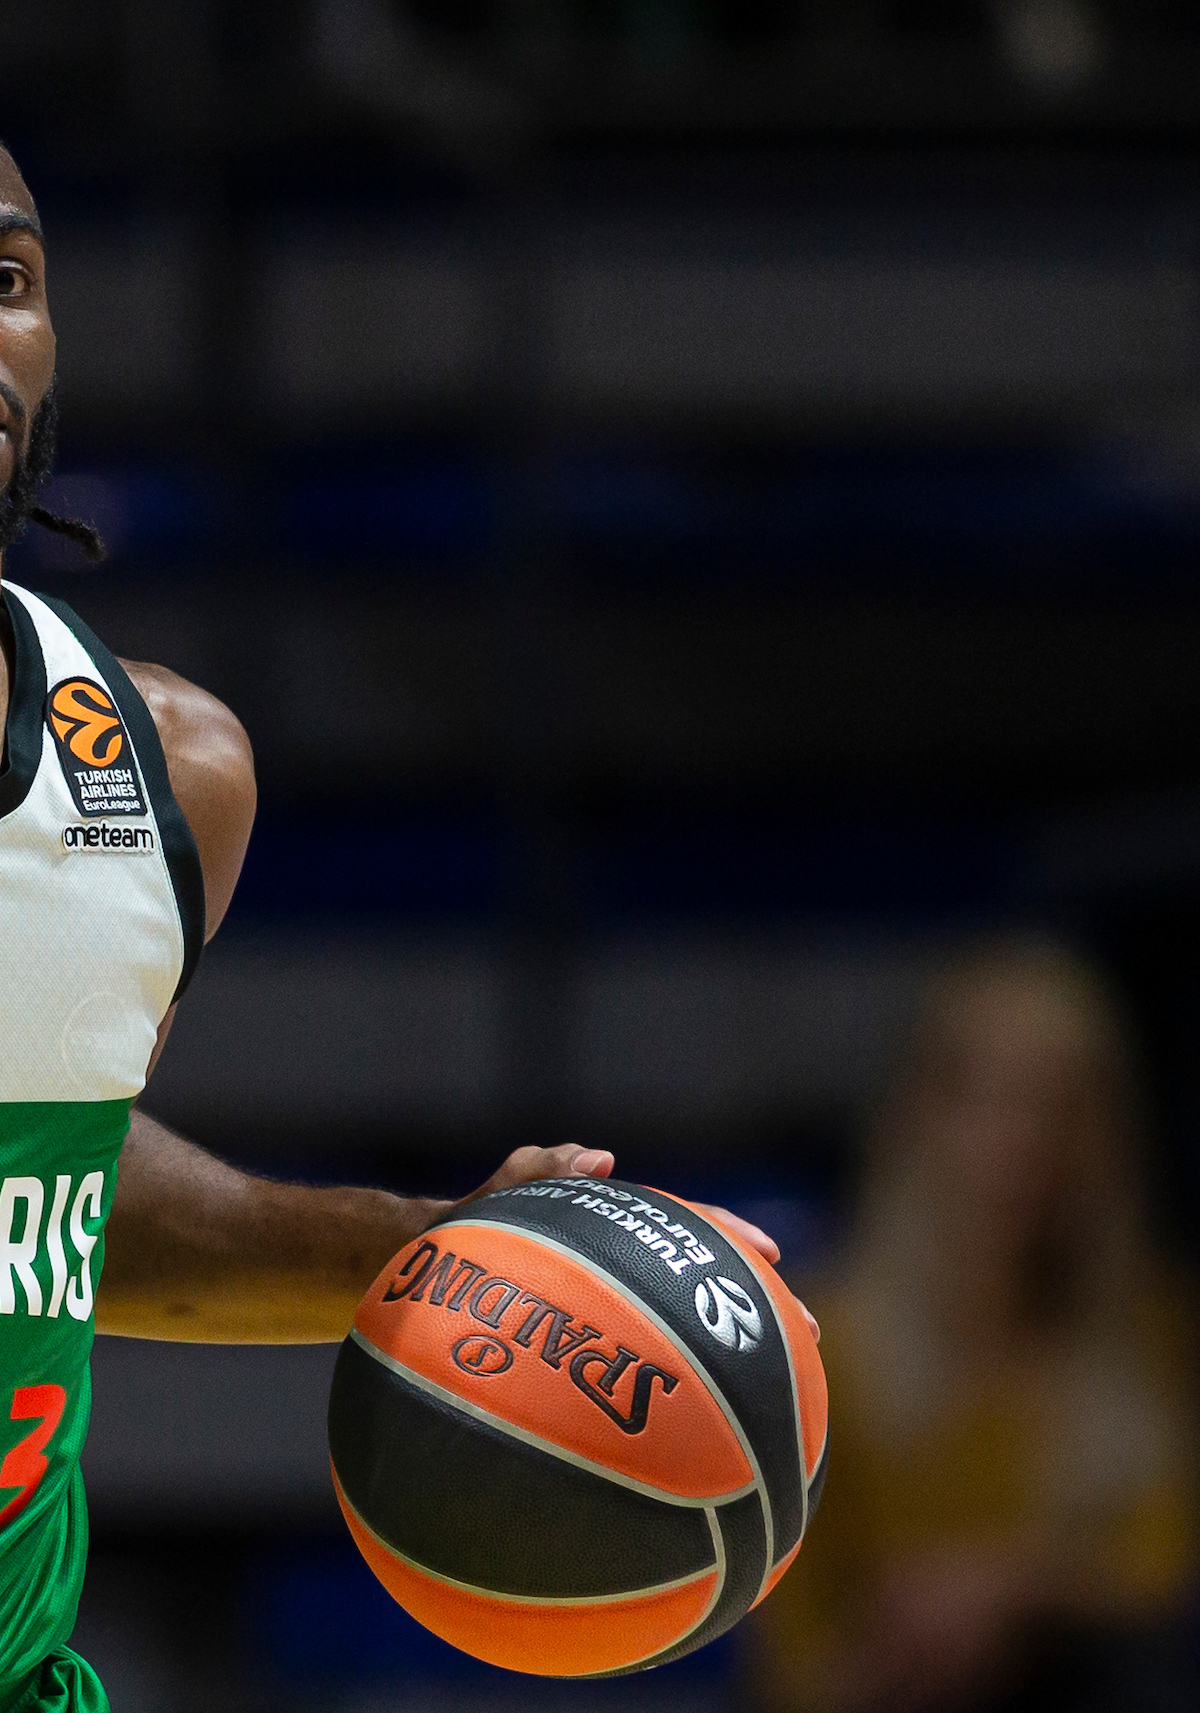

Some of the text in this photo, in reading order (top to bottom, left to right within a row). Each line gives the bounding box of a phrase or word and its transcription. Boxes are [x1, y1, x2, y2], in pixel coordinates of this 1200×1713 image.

[73, 769, 134, 785] TURKISH
[80, 783, 137, 799] AIRLINES
[83, 799, 141, 812] EuroLeague
[570, 1193, 692, 1276] TURKISH
[380, 1239, 680, 1436] SPALDING
